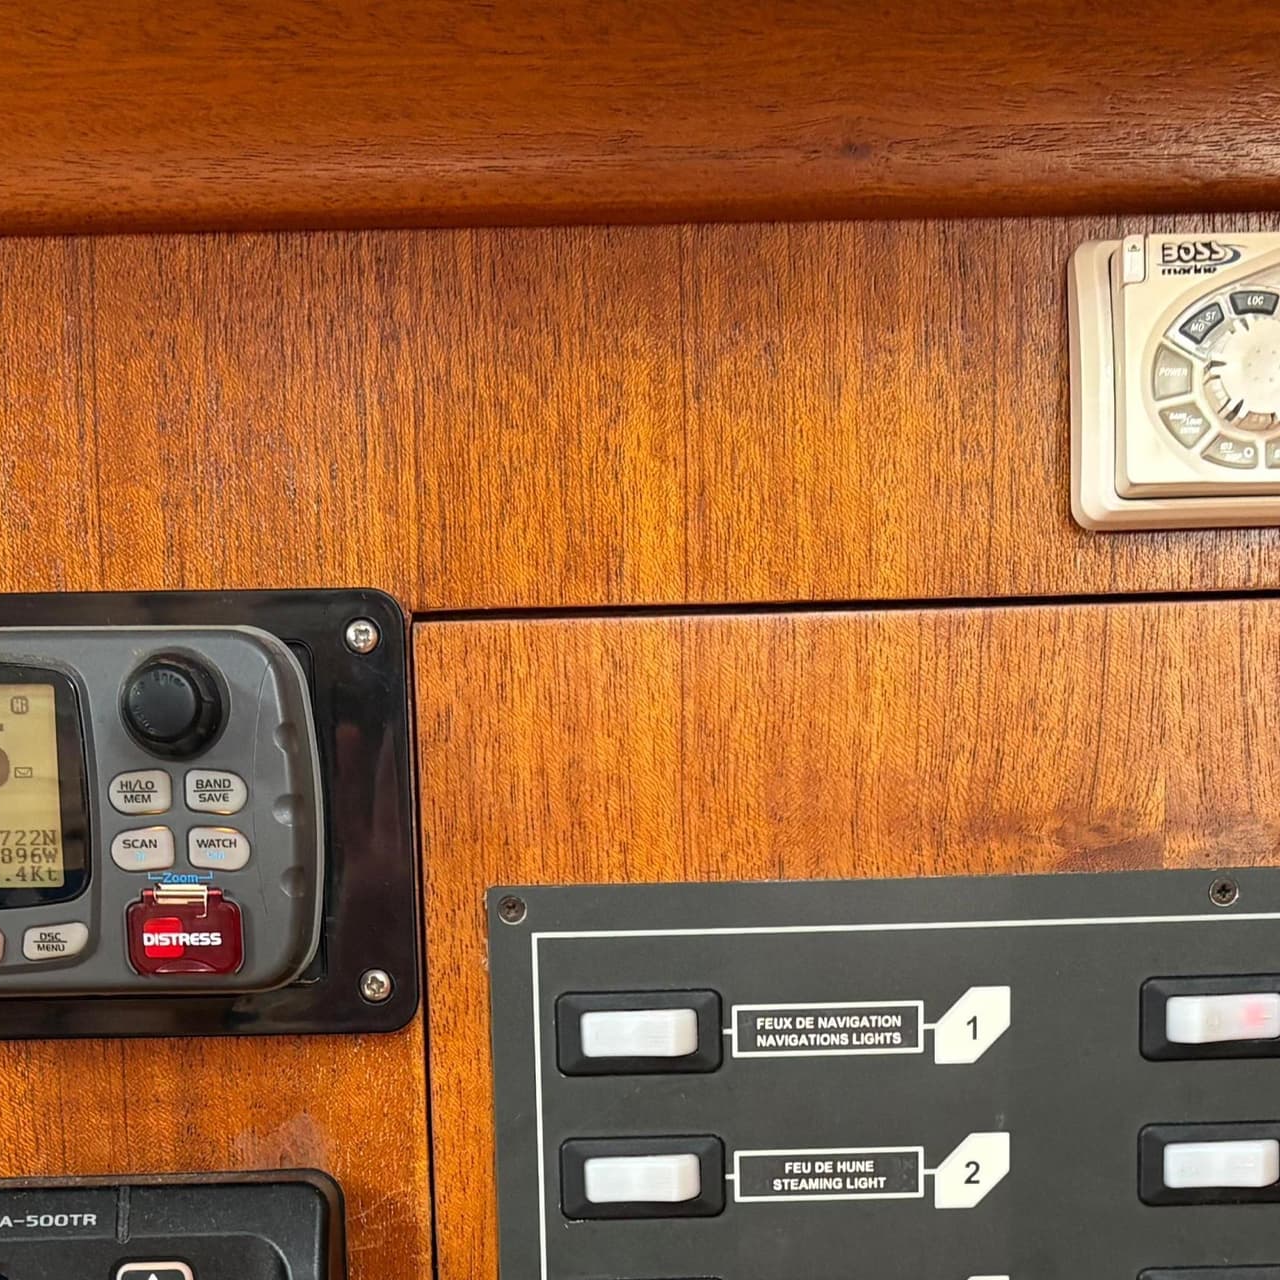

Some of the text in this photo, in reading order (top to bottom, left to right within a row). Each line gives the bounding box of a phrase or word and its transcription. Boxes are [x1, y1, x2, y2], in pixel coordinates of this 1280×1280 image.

[120, 780, 154, 791] HI/LO
[196, 779, 231, 788] BAND
[124, 794, 151, 803] MEM
[199, 793, 229, 802] SAVE
[122, 839, 157, 848] SCAN
[197, 839, 237, 848] WATCH
[163, 872, 198, 883] Zoom
[143, 933, 222, 946] DISTRESS
[37, 943, 65, 952] MENU
[757, 1016, 902, 1030] FEUX DE NAVIGATION
[966, 1016, 978, 1040] 1
[757, 1032, 902, 1047] NAVIGATIONS LIGHTS
[964, 1161, 980, 1184] 2
[773, 1177, 886, 1190] STEAMING LIGHT
